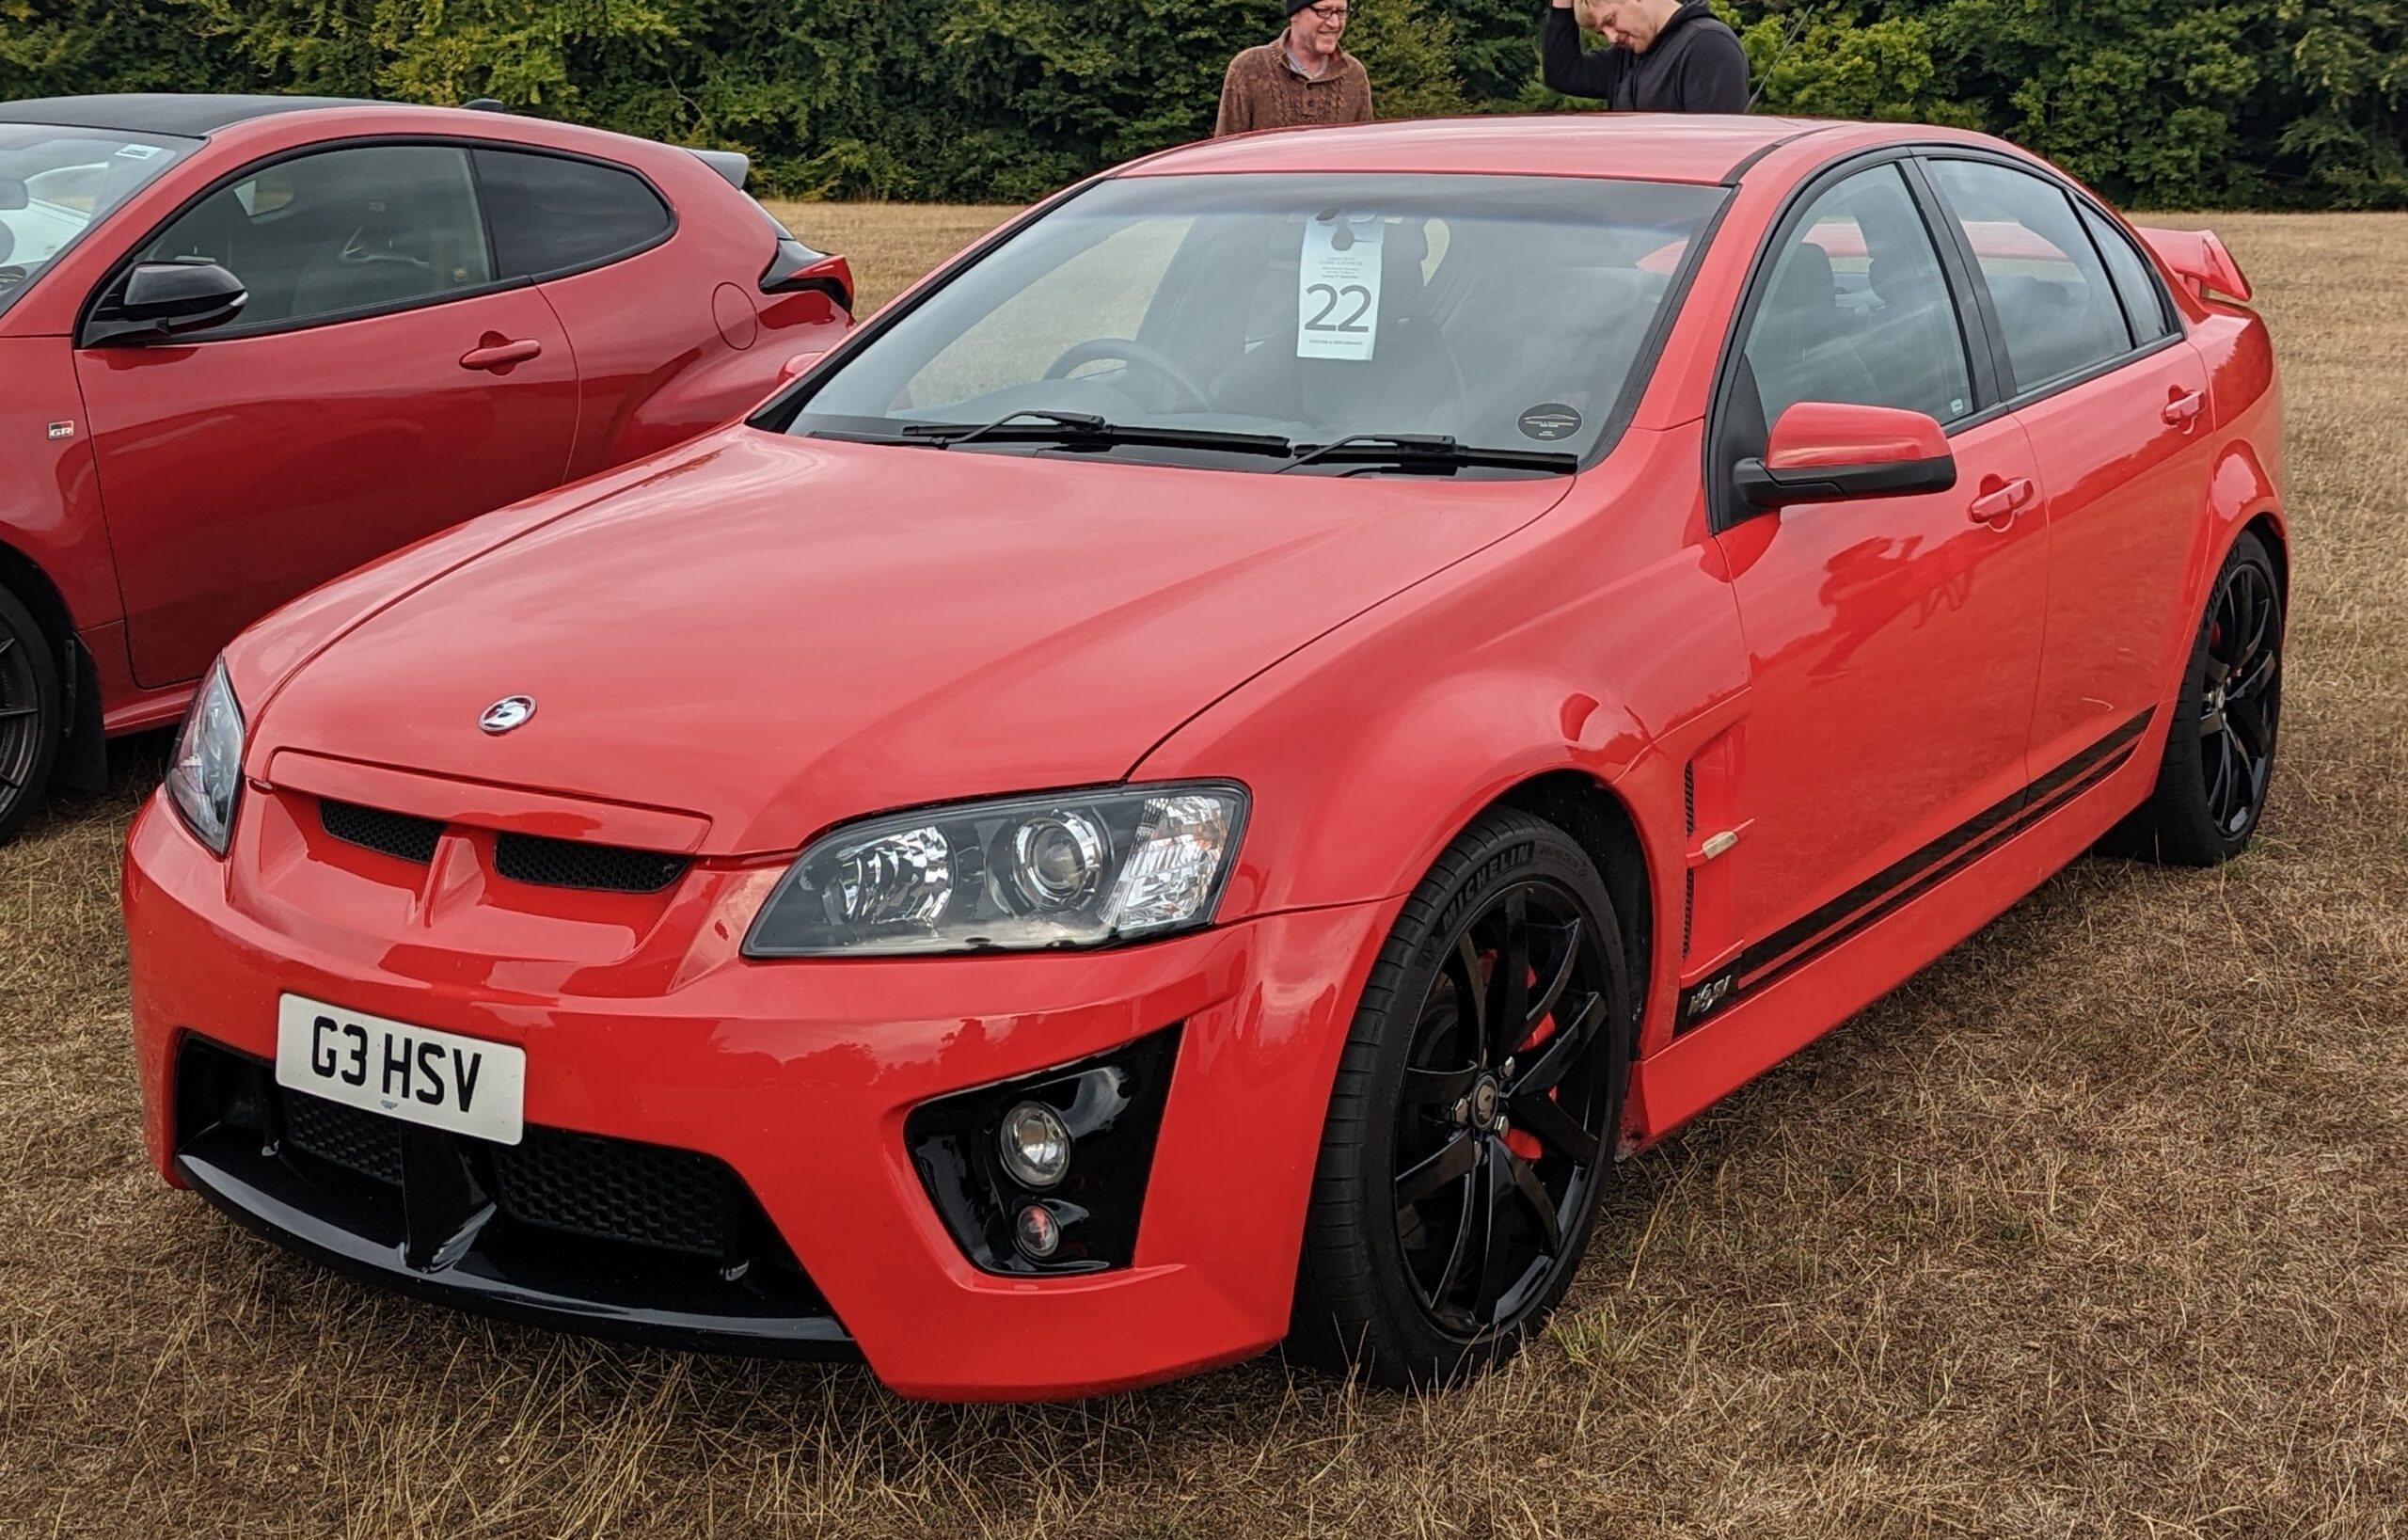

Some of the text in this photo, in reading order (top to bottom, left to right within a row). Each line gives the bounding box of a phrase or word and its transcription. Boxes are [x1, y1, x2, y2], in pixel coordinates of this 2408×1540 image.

[1304, 283, 1371, 333] 22
[1441, 844, 1530, 932] MICHELIN
[311, 1015, 483, 1114] G3 HSV
